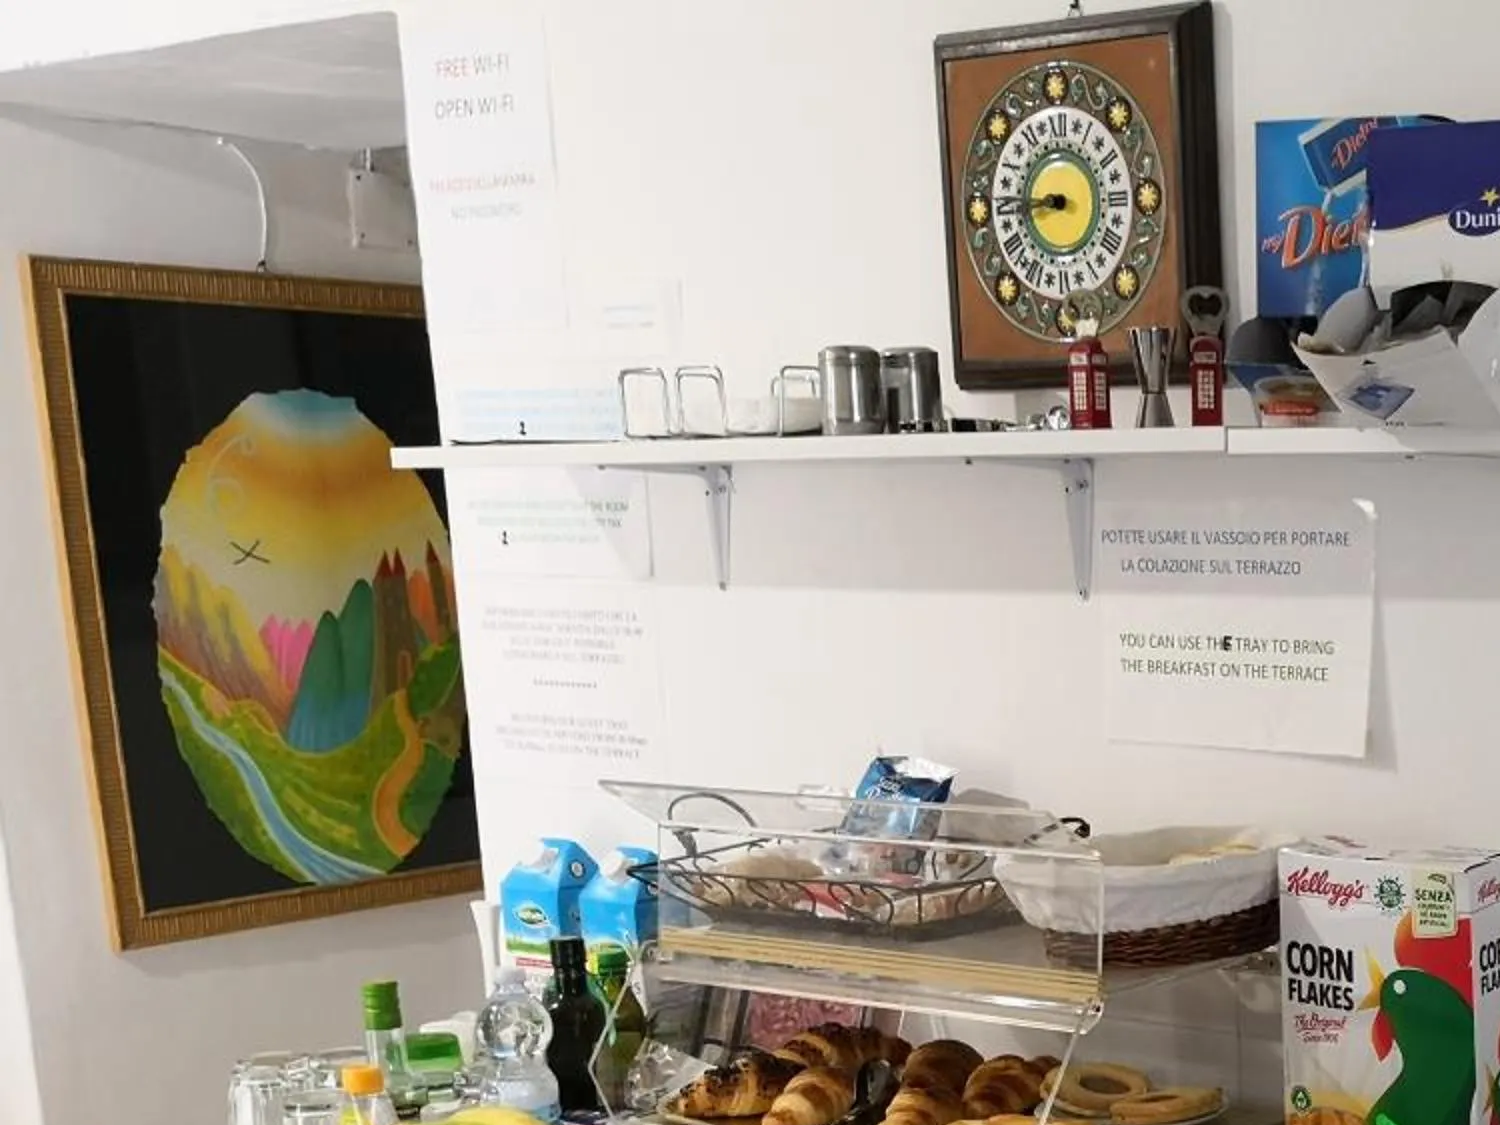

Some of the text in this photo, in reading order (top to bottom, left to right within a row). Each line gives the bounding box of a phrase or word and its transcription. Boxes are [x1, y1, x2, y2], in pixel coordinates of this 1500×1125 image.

[434, 53, 509, 78] FREE WI-FI
[434, 98, 473, 119] OPEN
[1279, 205, 1368, 269] Diet
[1101, 529, 1350, 547] POTETE USARE IL VASSOIO PER PORTARE
[1121, 558, 1301, 576] LA COLAZIONE SUL TERRAZZO
[1120, 633, 1335, 655] YOU CAN USE THE TRAY TO BRING
[1120, 658, 1329, 681] THE BREAKFAST ON THE TERRACE
[1287, 866, 1365, 906] Kellogg's
[1415, 888, 1453, 903] SENZA
[1286, 941, 1353, 982] CORN
[1288, 978, 1355, 1011] FLAKES
